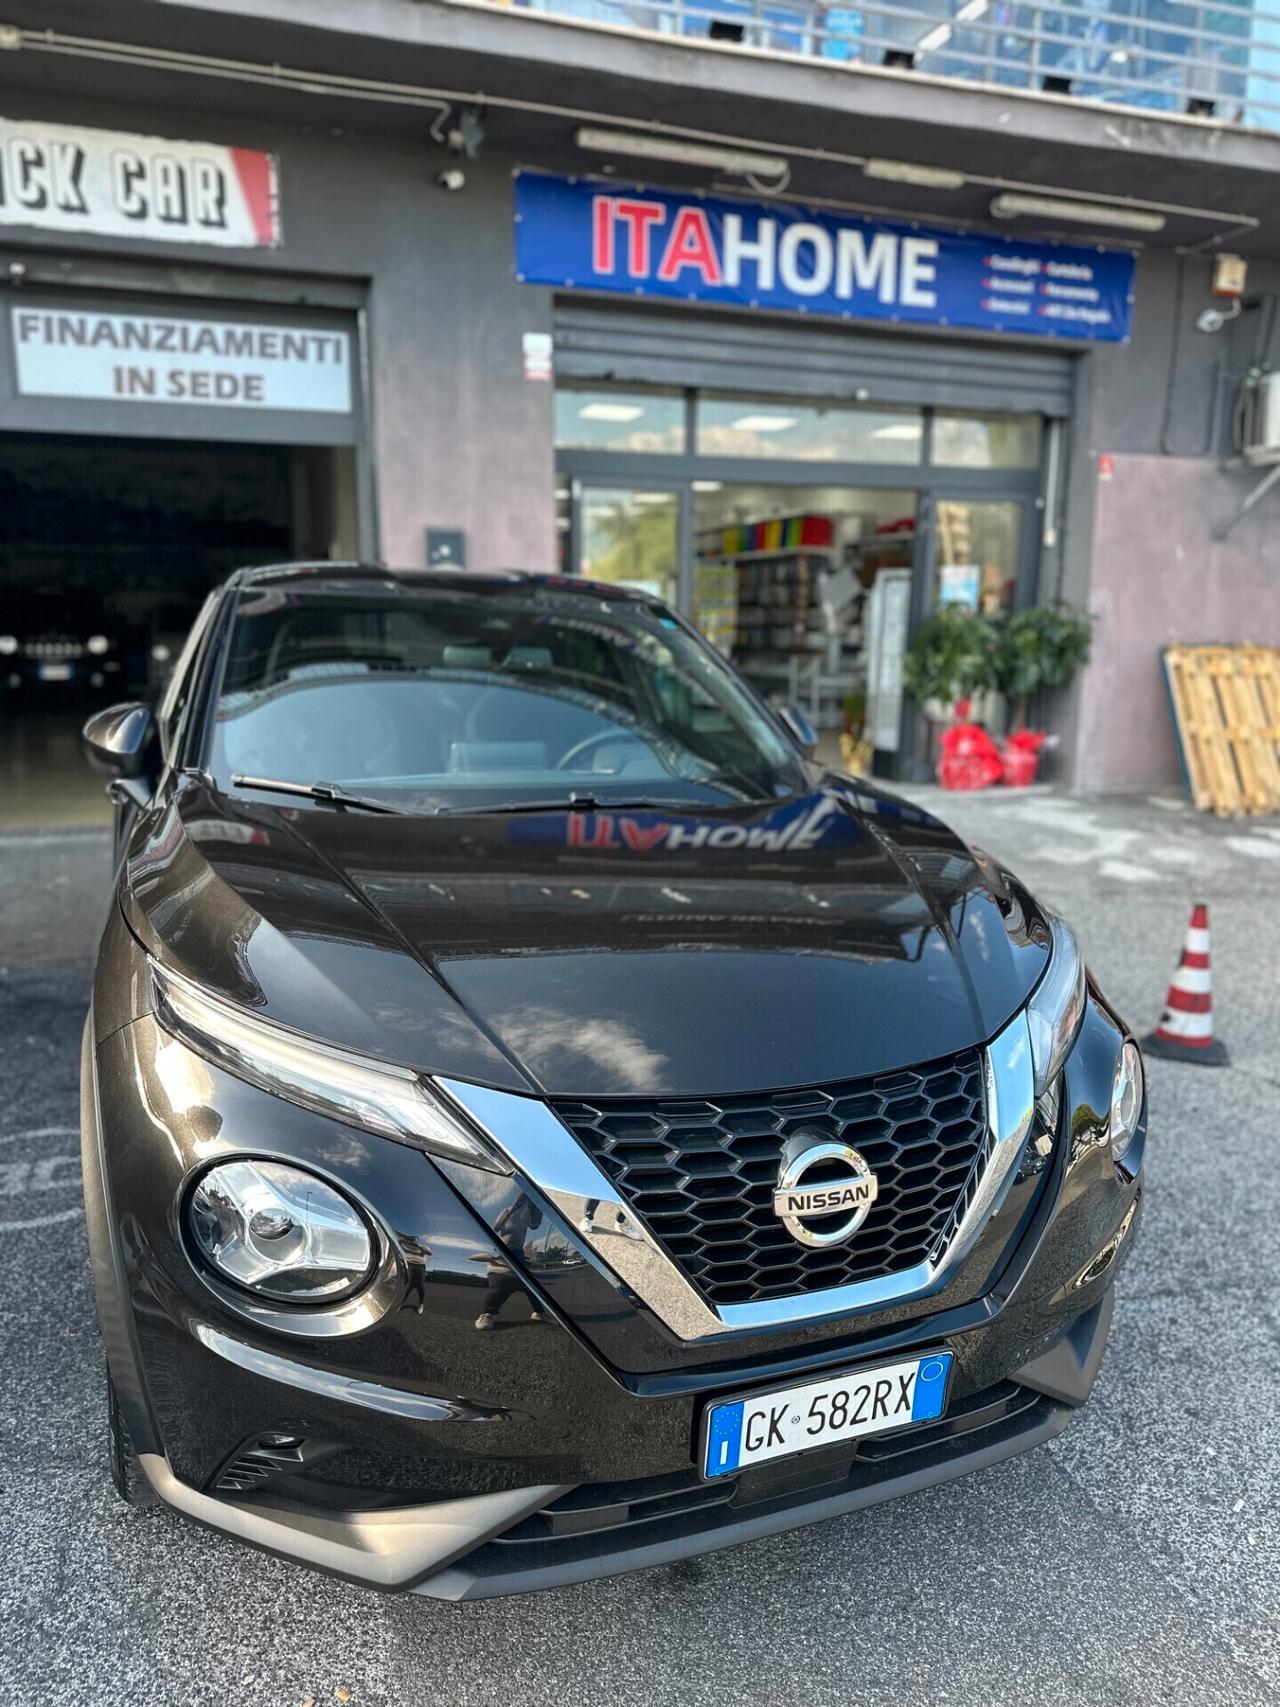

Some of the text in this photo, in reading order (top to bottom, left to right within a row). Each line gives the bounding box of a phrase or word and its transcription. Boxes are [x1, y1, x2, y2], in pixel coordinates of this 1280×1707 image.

[0, 136, 228, 229] CK CAR
[593, 195, 939, 309] ITAHOME
[18, 313, 344, 365] FINANZIAMENTI
[113, 366, 266, 402] IN SEDE
[788, 1184, 869, 1211] NISSAN
[744, 1372, 916, 1452] GK 582RX
